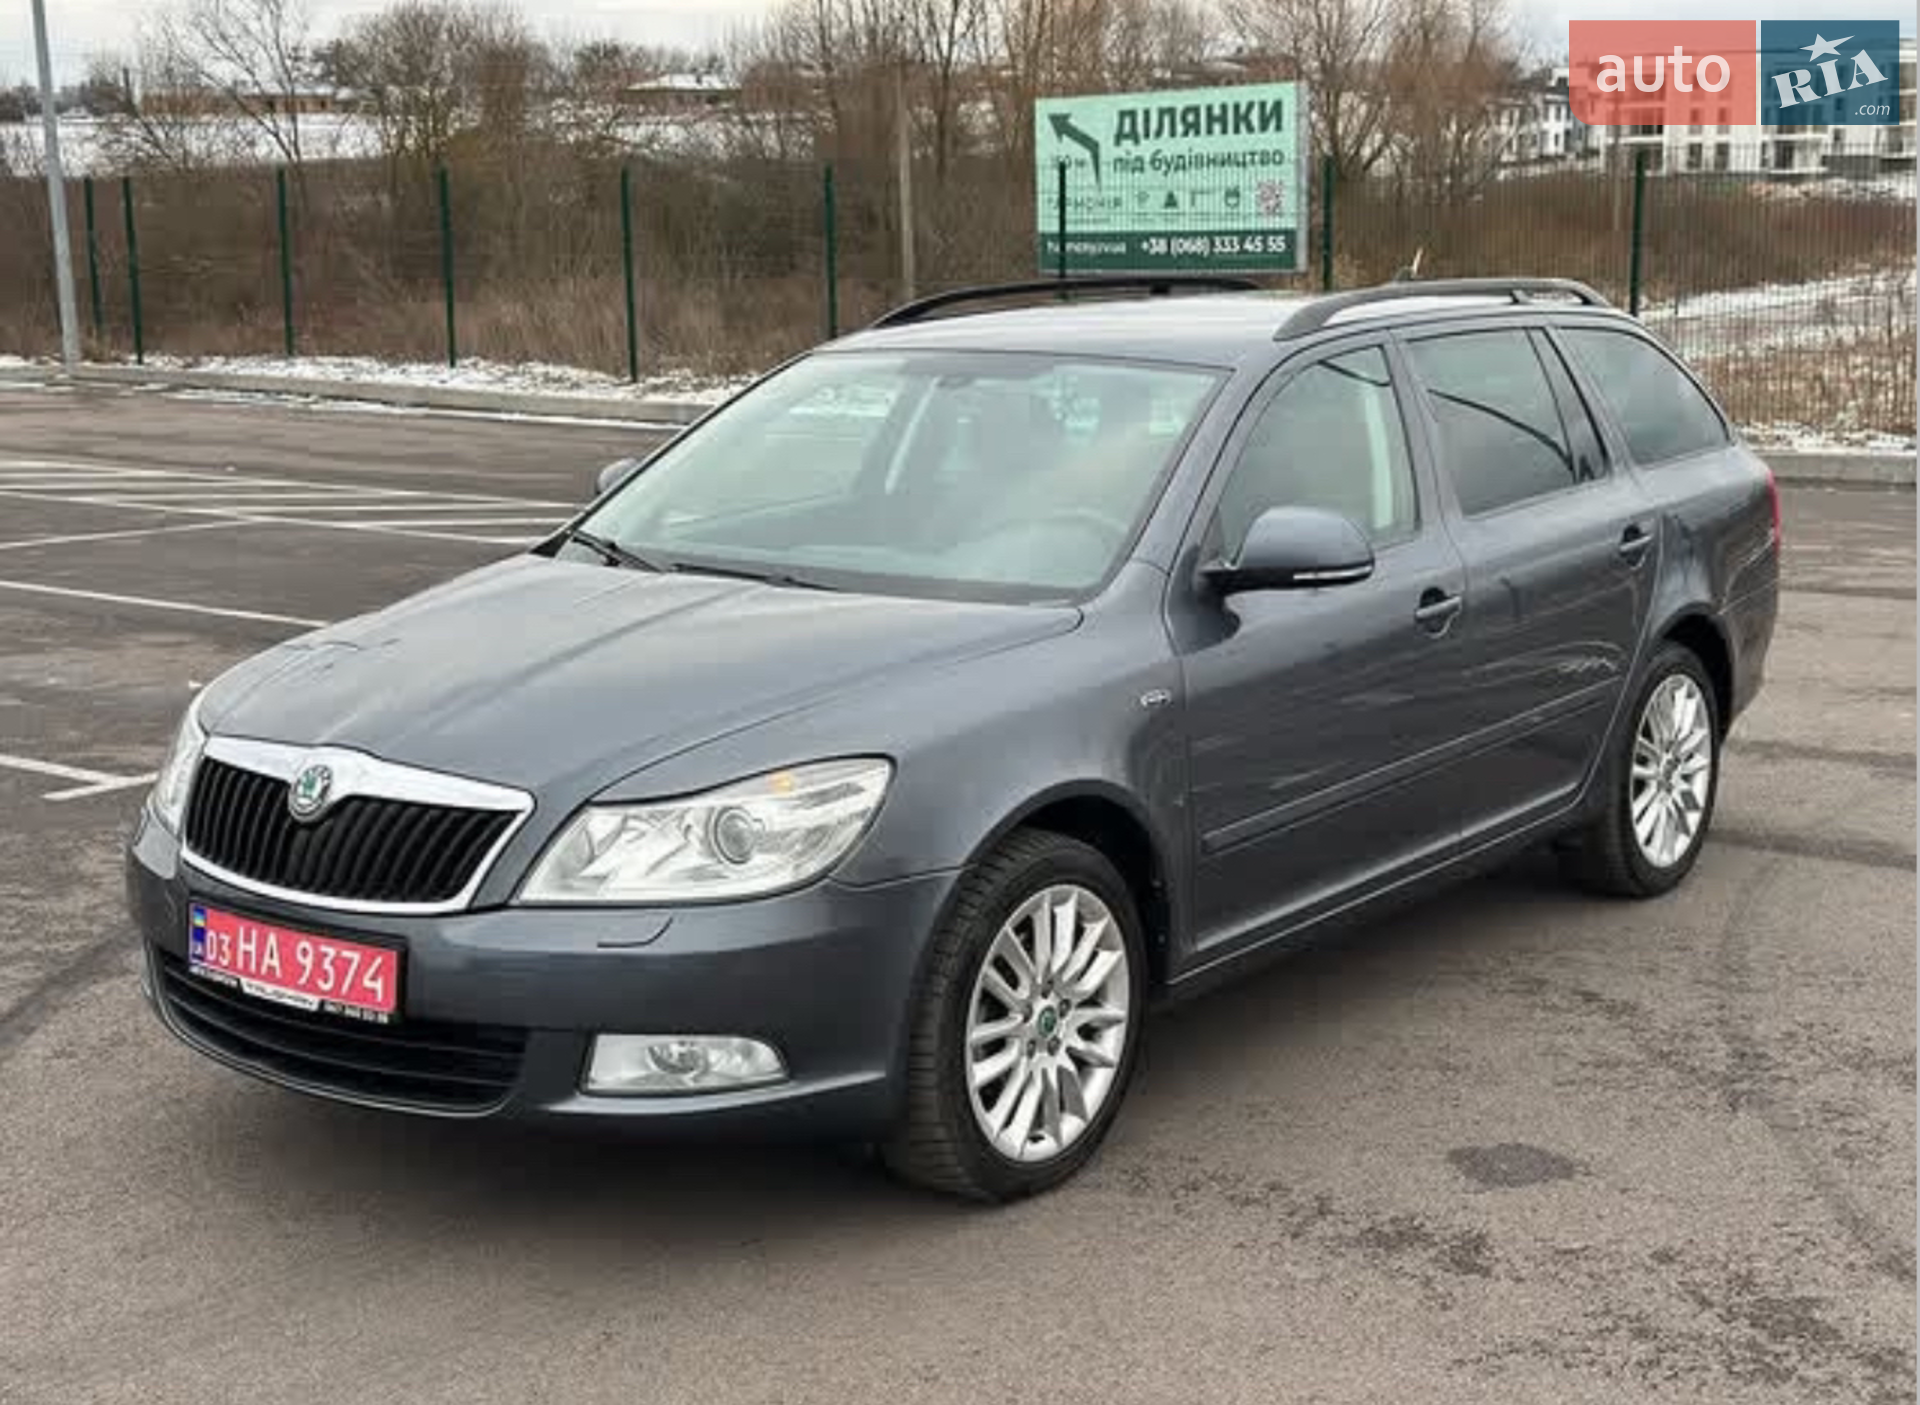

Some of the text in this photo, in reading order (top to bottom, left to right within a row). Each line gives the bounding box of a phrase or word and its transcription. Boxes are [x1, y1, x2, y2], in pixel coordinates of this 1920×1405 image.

[1113, 99, 1283, 147] ДІЛЯНКИ
[1113, 147, 1286, 177] під будівництво
[1141, 237, 1169, 256] +38
[1213, 236, 1240, 253] 333
[1243, 236, 1264, 252] 45
[1267, 235, 1286, 252] 55
[206, 929, 231, 966] 03
[296, 940, 384, 1003] 9374
